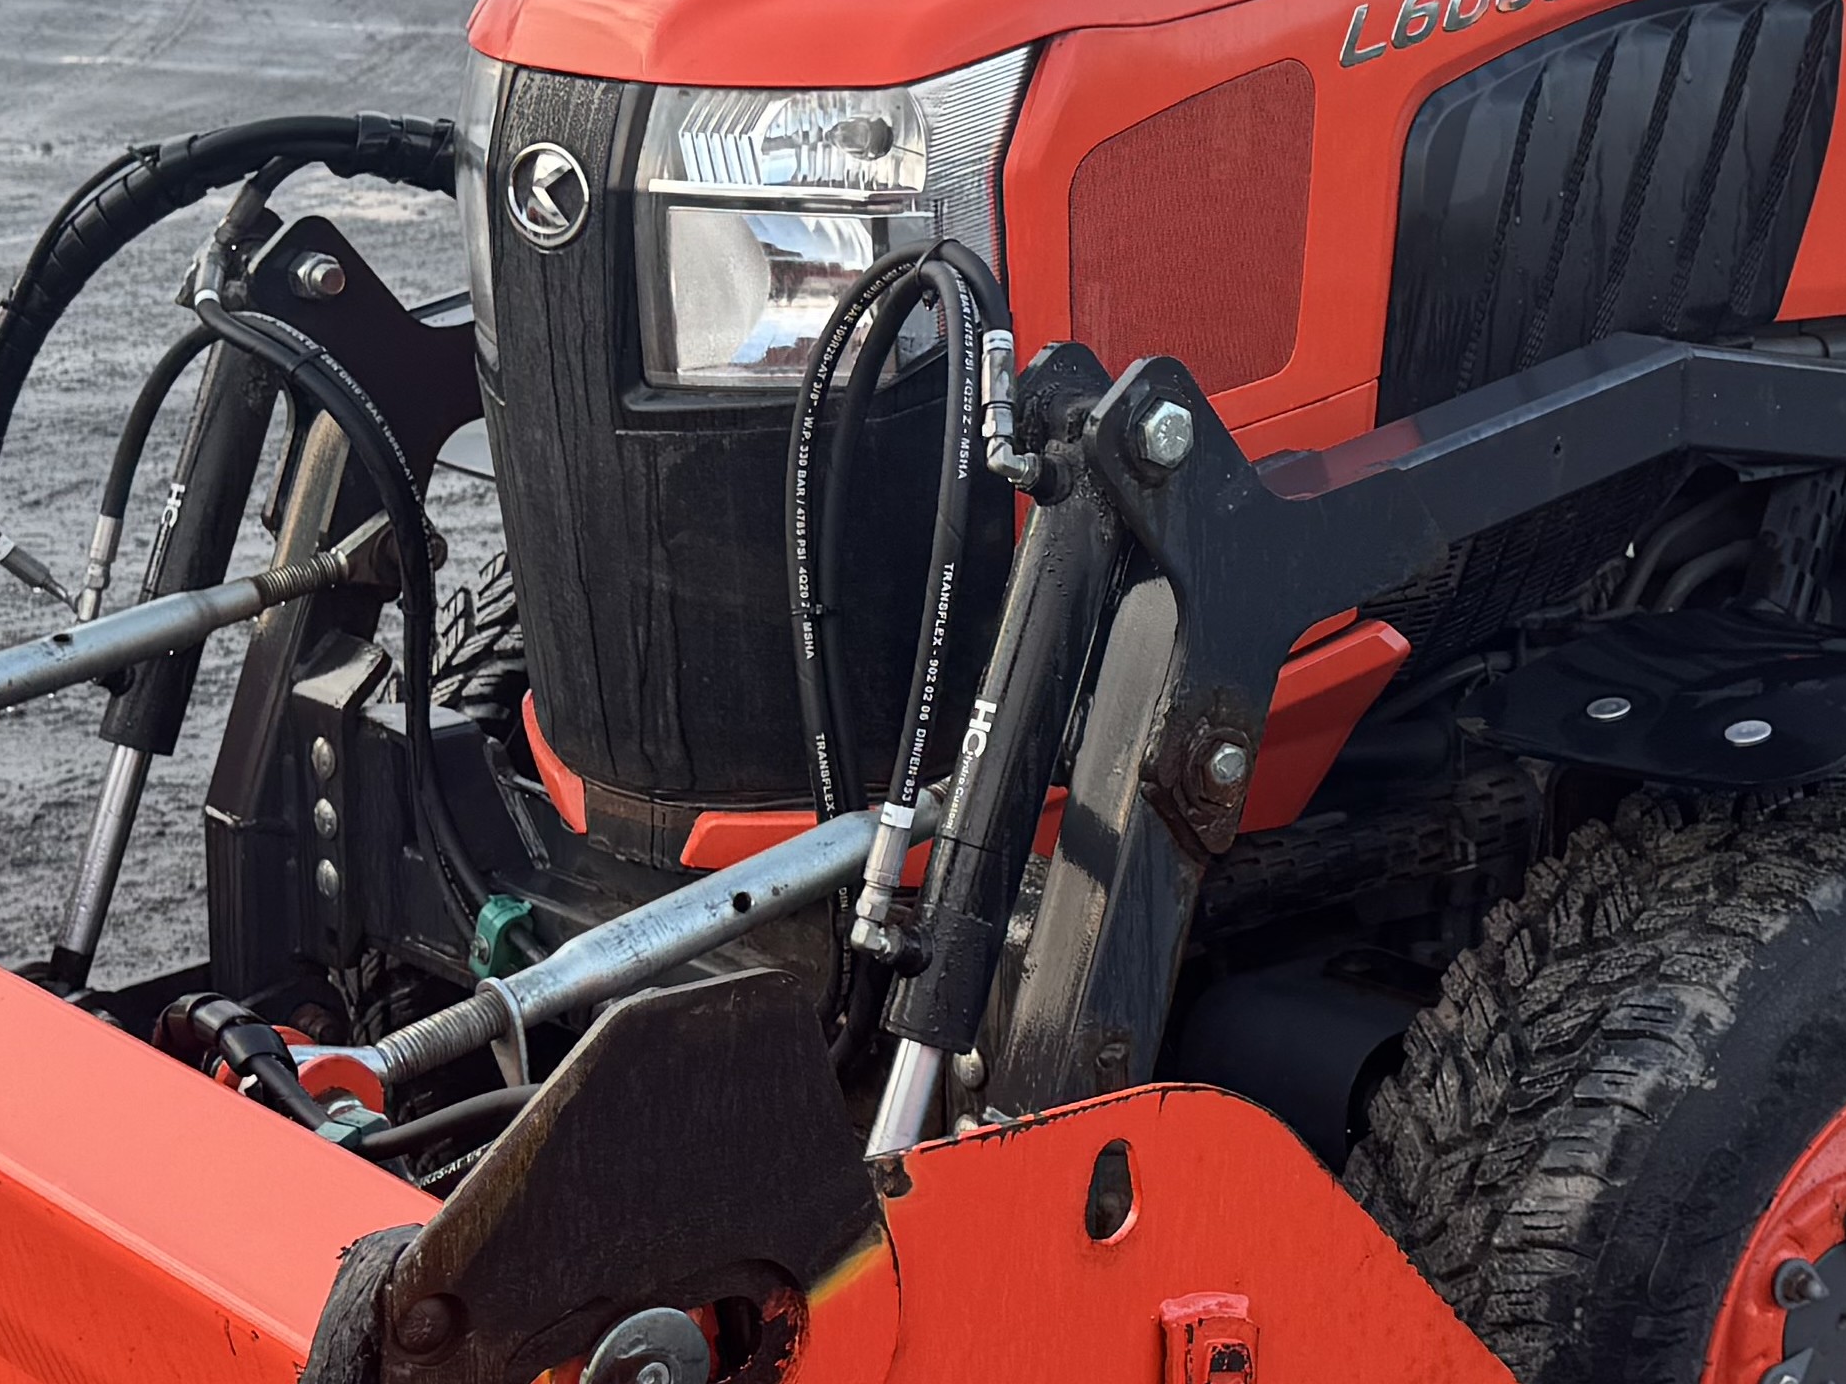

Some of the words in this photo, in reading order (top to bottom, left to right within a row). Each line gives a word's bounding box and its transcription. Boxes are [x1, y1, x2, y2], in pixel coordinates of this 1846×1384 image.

[843, 302, 862, 324] SAE
[801, 416, 815, 442] W.P.
[798, 444, 810, 467] 330
[957, 437, 971, 480] MSHA
[795, 469, 807, 497] BAR
[160, 483, 185, 528] HC
[796, 538, 806, 561] PSI
[798, 566, 810, 599] 4Q20
[931, 561, 955, 646] TRANSFLEX
[802, 621, 815, 660] MSHA
[922, 684, 935, 702] 02
[961, 698, 997, 758] HC
[815, 731, 837, 812] TRANSFLEX
